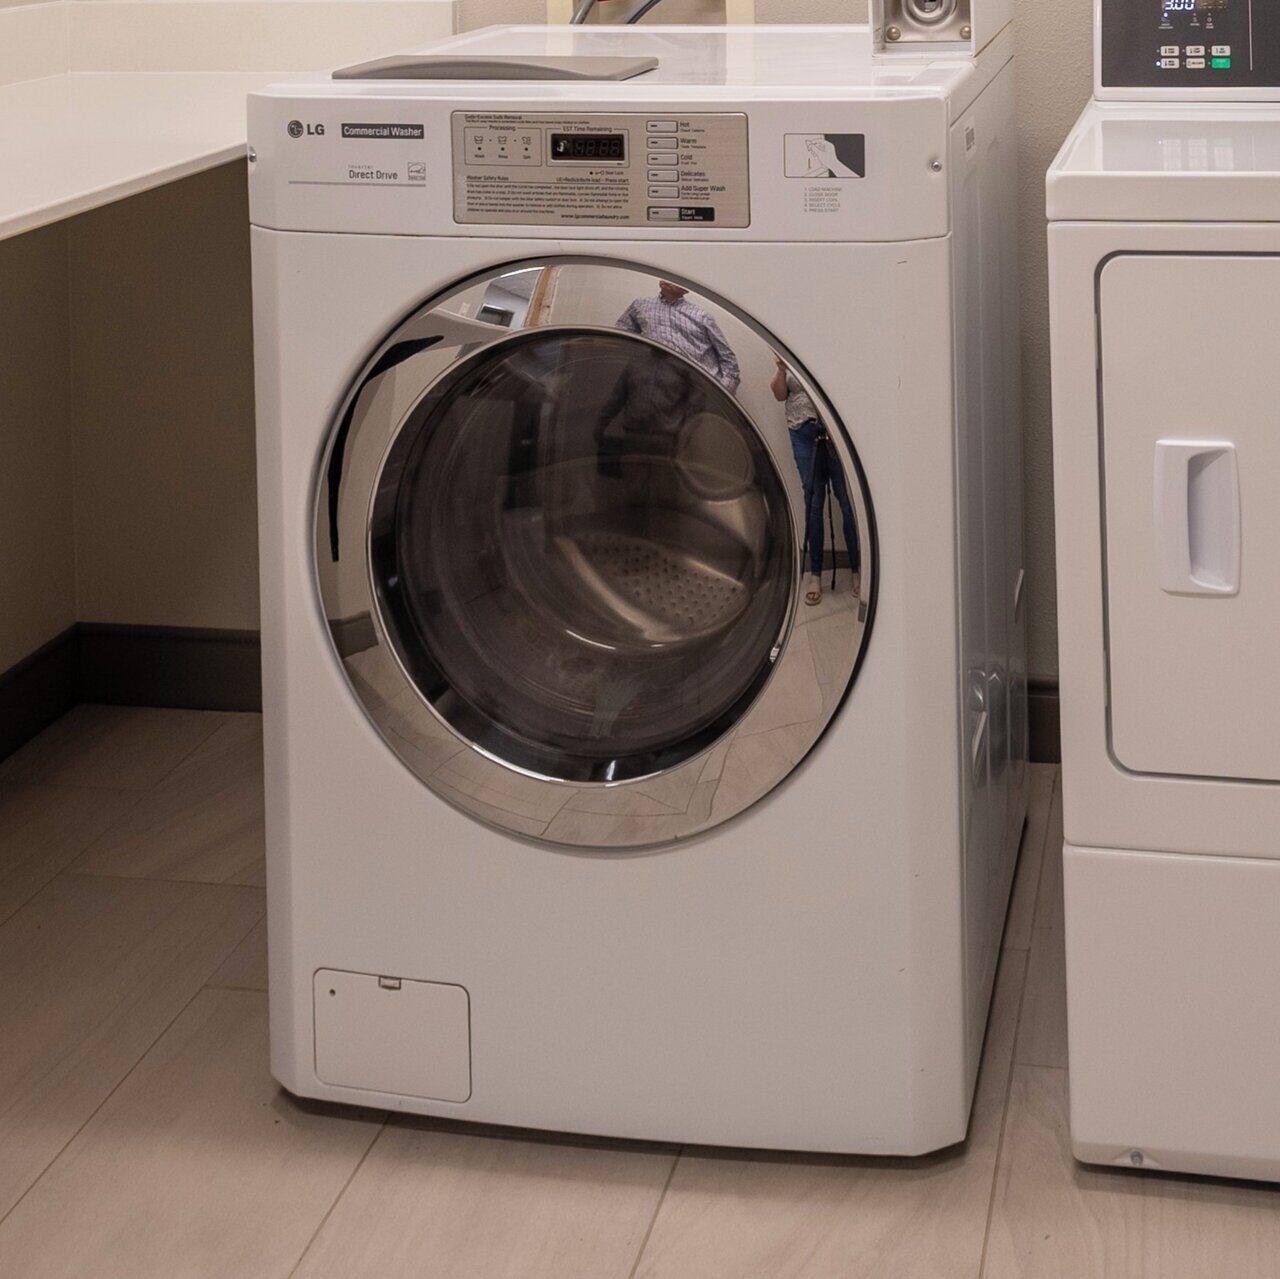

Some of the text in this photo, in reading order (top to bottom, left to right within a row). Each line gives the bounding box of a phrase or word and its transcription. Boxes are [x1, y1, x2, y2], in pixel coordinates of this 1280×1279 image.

[306, 123, 325, 136] LG
[343, 125, 422, 137] Commercial Washer
[349, 170, 374, 180] Direct
[376, 170, 399, 180] Drive
